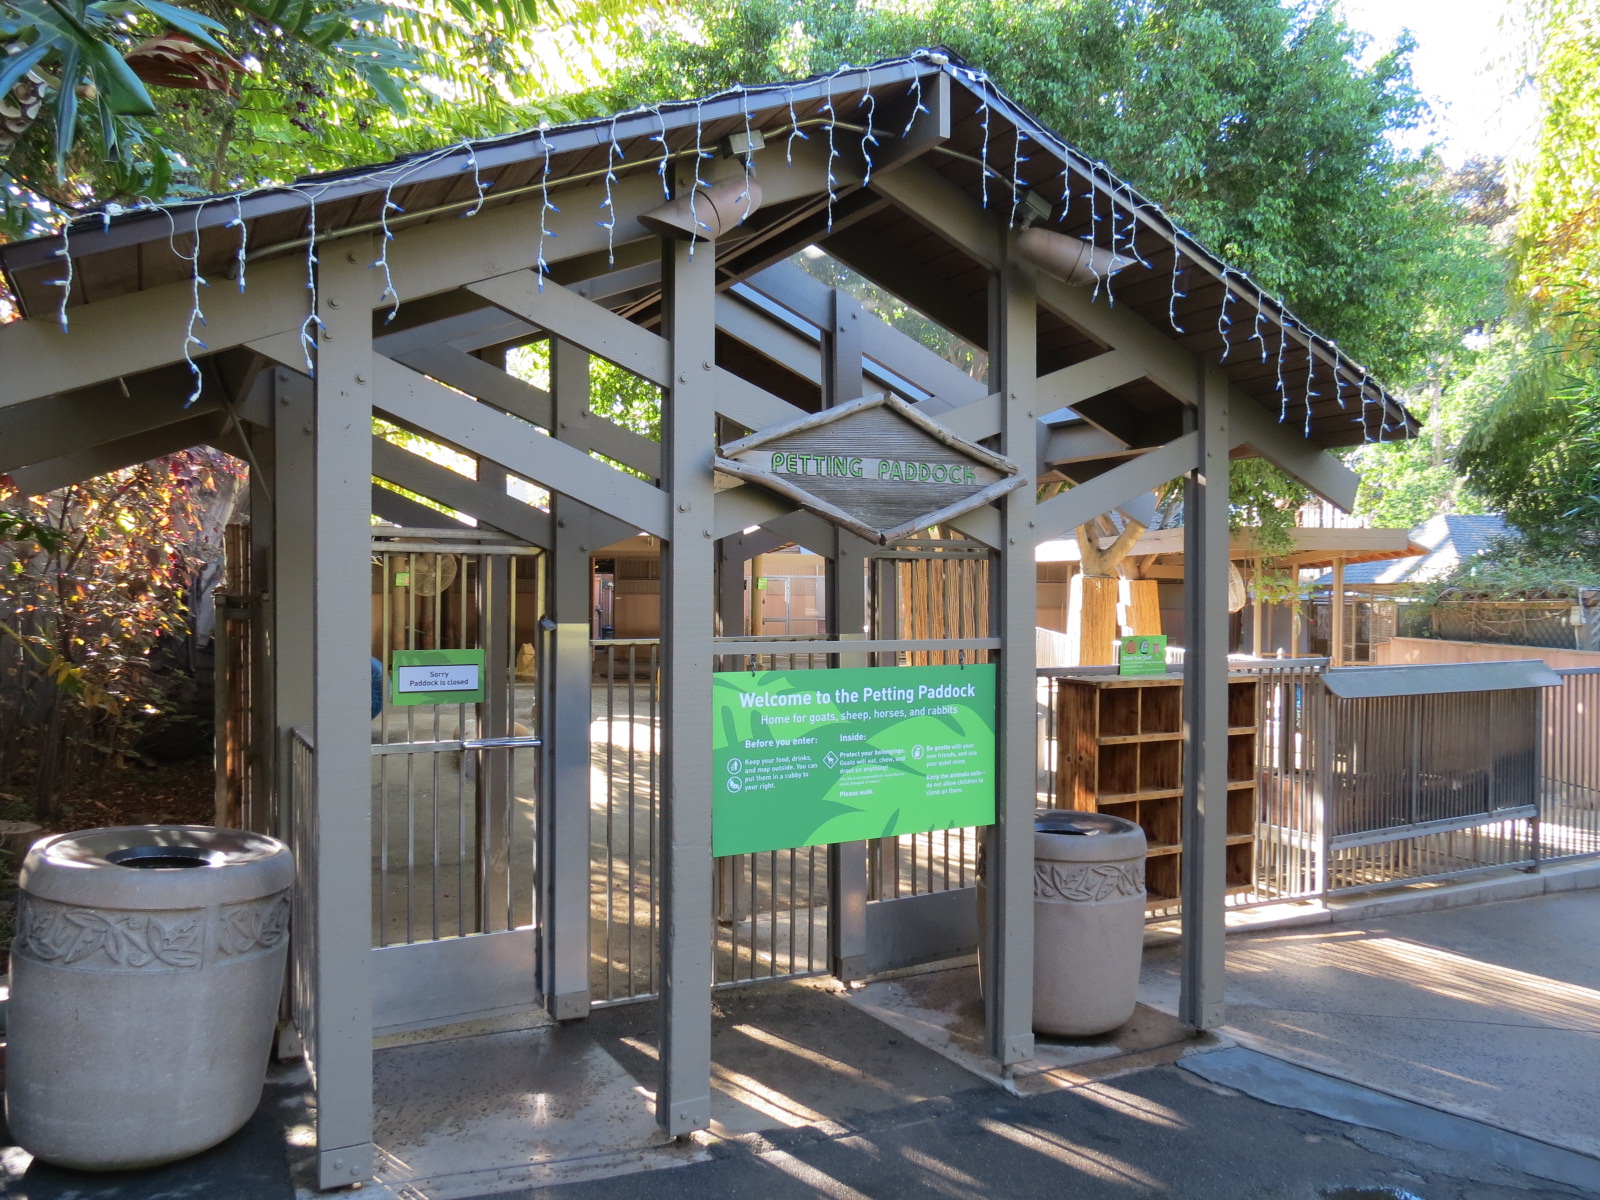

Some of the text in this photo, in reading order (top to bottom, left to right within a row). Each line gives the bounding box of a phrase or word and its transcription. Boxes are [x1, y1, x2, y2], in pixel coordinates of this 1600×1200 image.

[771, 453, 977, 486] PETTING PADDOCK
[409, 679, 438, 687] Paddock
[739, 683, 976, 708] Welcome to the Petting Paddock
[761, 704, 958, 724] Home for goats, sheep, horses, and rabbits
[745, 737, 818, 749] Before you enter:
[840, 732, 866, 742] Inside:
[760, 782, 775, 790] right.
